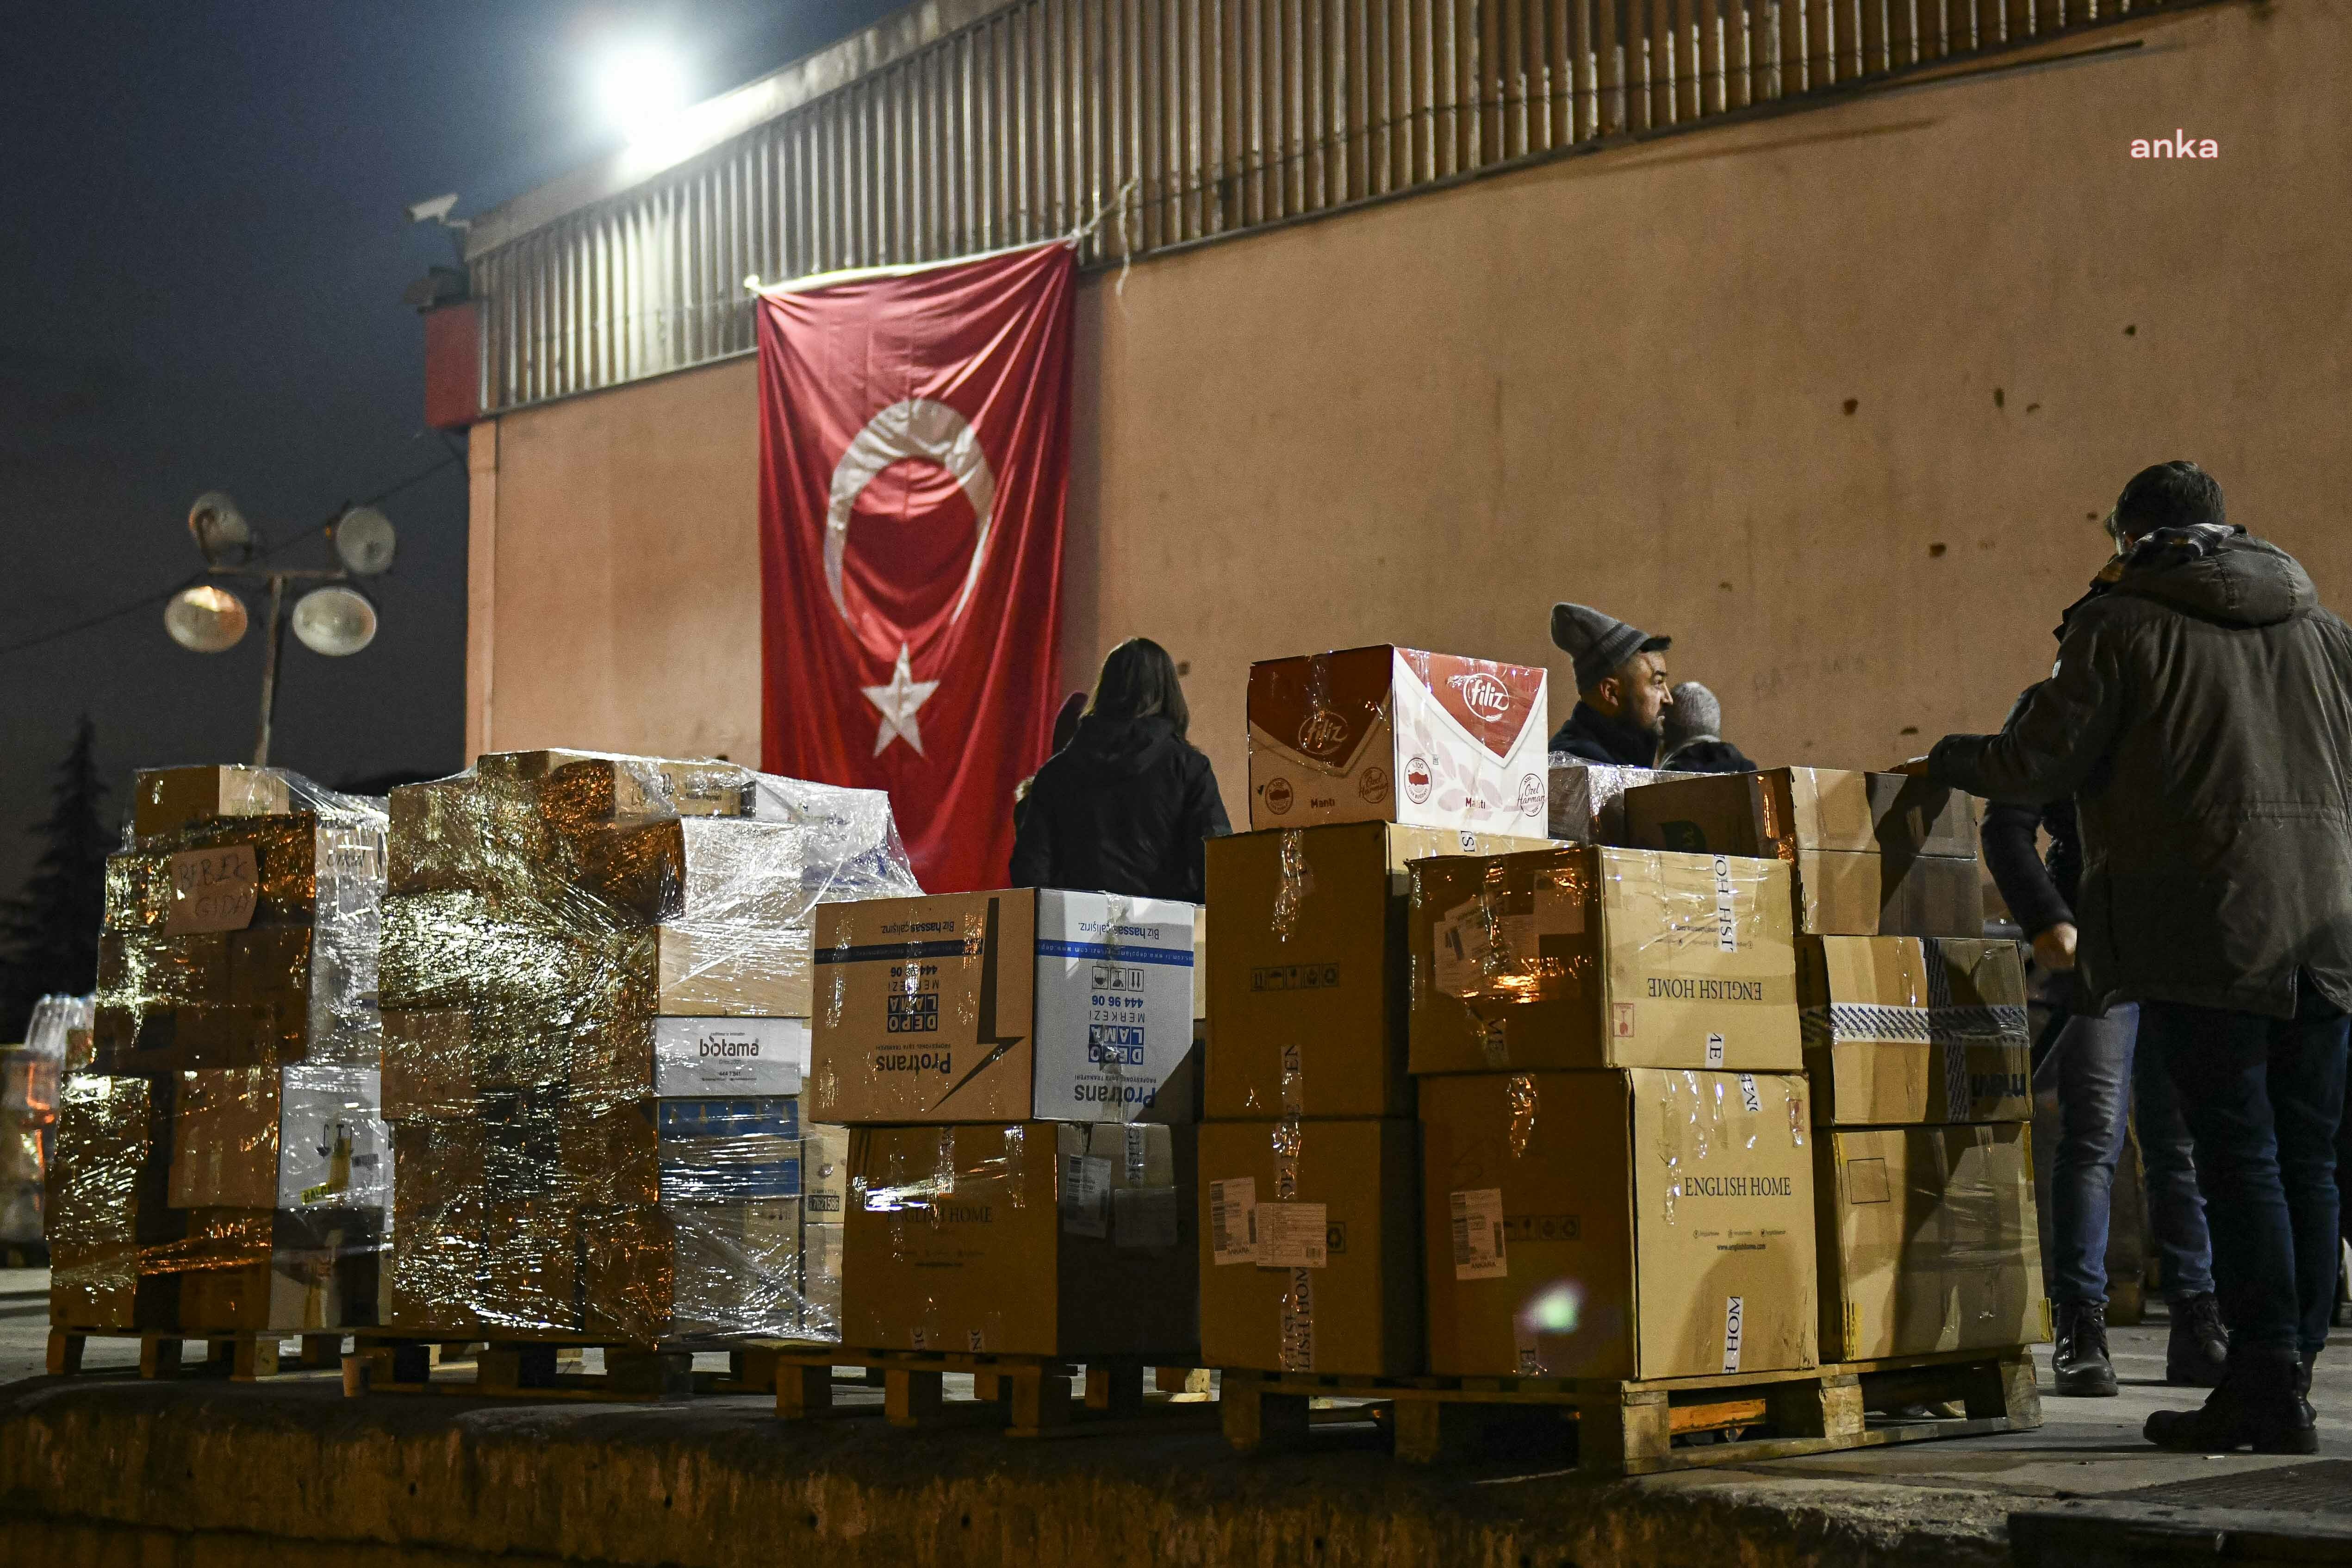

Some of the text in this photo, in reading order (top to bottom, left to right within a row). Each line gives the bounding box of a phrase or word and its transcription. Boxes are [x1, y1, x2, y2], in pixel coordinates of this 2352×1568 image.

[1471, 679, 1508, 711] filiz
[1307, 716, 1348, 744] filiz
[1517, 794, 1546, 807] Harman
[1147, 928, 1159, 940] Biz
[890, 967, 902, 977] 06
[1648, 978, 1762, 1001] ENGLISH HOME
[1092, 995, 1144, 1008] 444 96 06
[889, 1014, 938, 1031] DEPO
[1091, 1026, 1144, 1044] LAMA
[699, 1035, 759, 1057] botama
[875, 1052, 952, 1075] Protrans
[1074, 1084, 1156, 1108] Protrans
[1685, 1177, 1792, 1197] ENGLISH HOME
[950, 1205, 993, 1222] HOME
